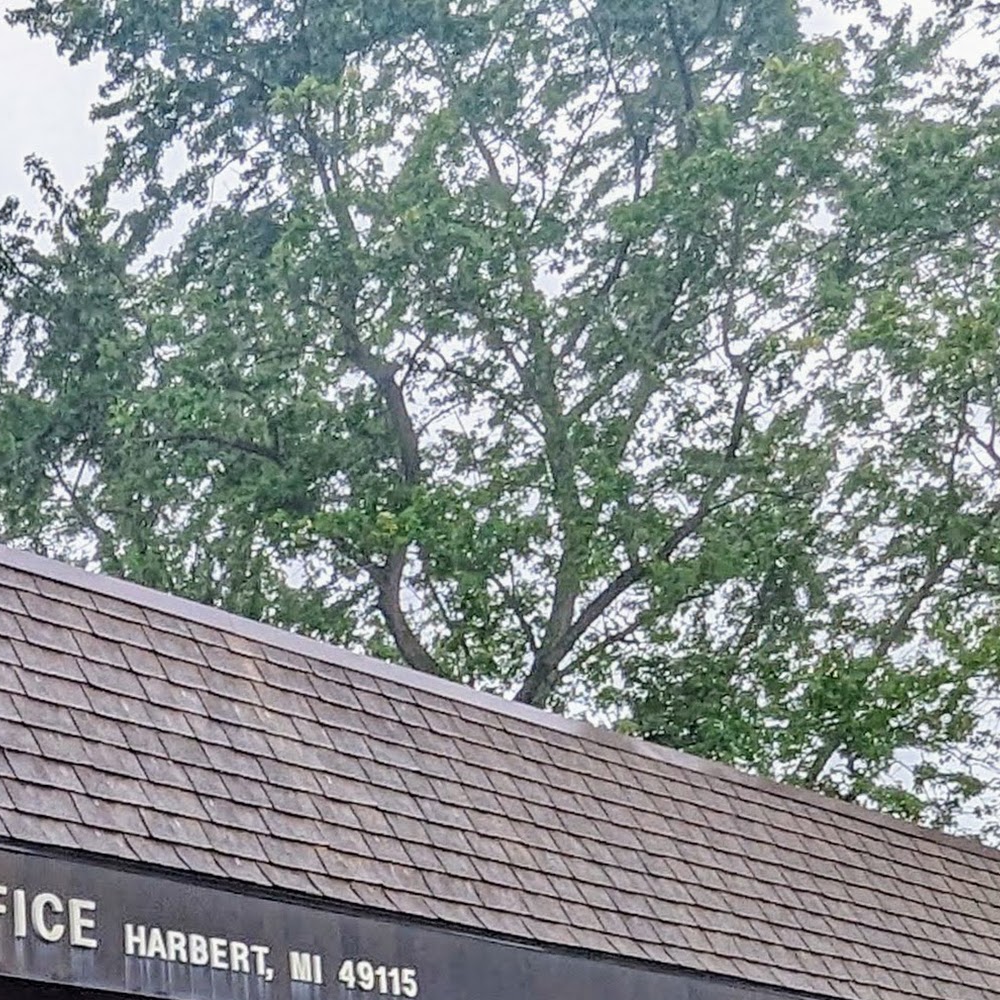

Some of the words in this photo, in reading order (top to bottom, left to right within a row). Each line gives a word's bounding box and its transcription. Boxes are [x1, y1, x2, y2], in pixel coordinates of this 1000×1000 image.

[124, 922, 275, 982] HARBERT,
[290, 952, 324, 985] MI
[338, 960, 419, 999] 49115
